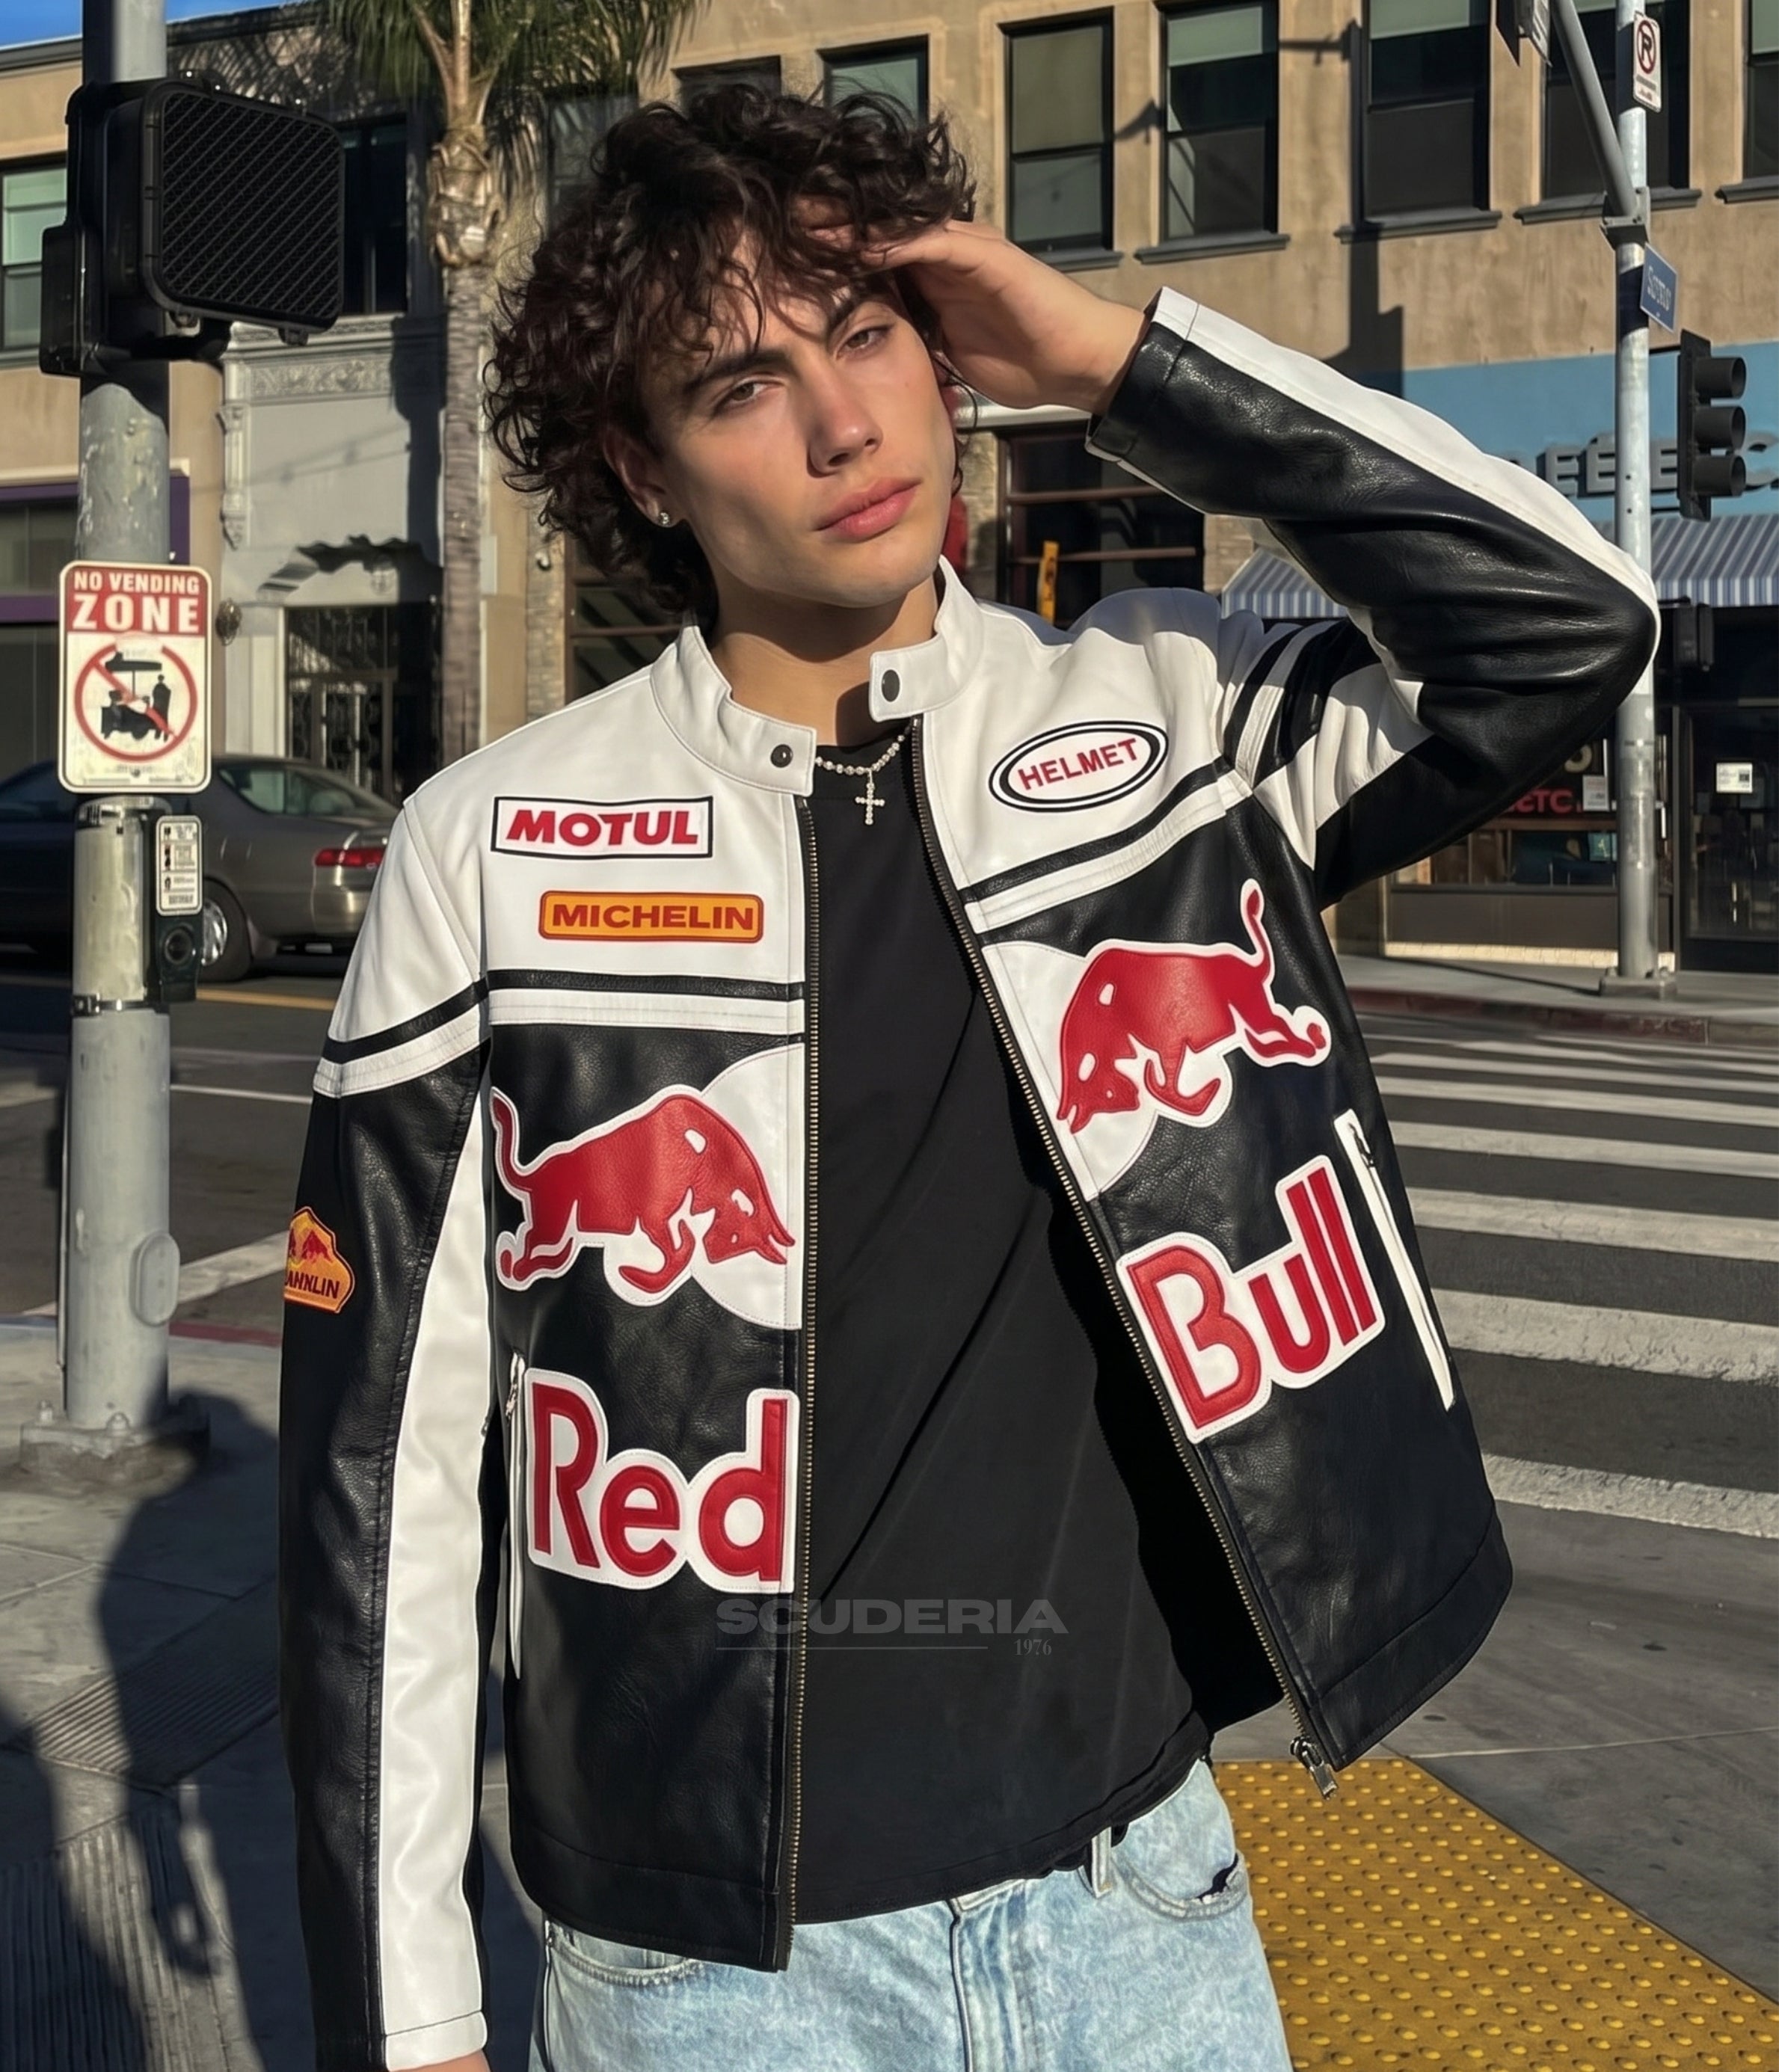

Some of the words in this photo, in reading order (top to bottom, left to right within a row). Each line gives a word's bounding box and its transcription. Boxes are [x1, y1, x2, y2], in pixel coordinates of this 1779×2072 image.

[74, 571, 103, 591] NO
[108, 573, 200, 595] VENDING
[72, 593, 200, 633] ZONE
[1018, 738, 1137, 790] HELMET
[506, 810, 698, 847] MOTUL
[552, 903, 754, 931] MICHELIN
[1125, 1166, 1377, 1430] Bull
[532, 1381, 788, 1582] Red
